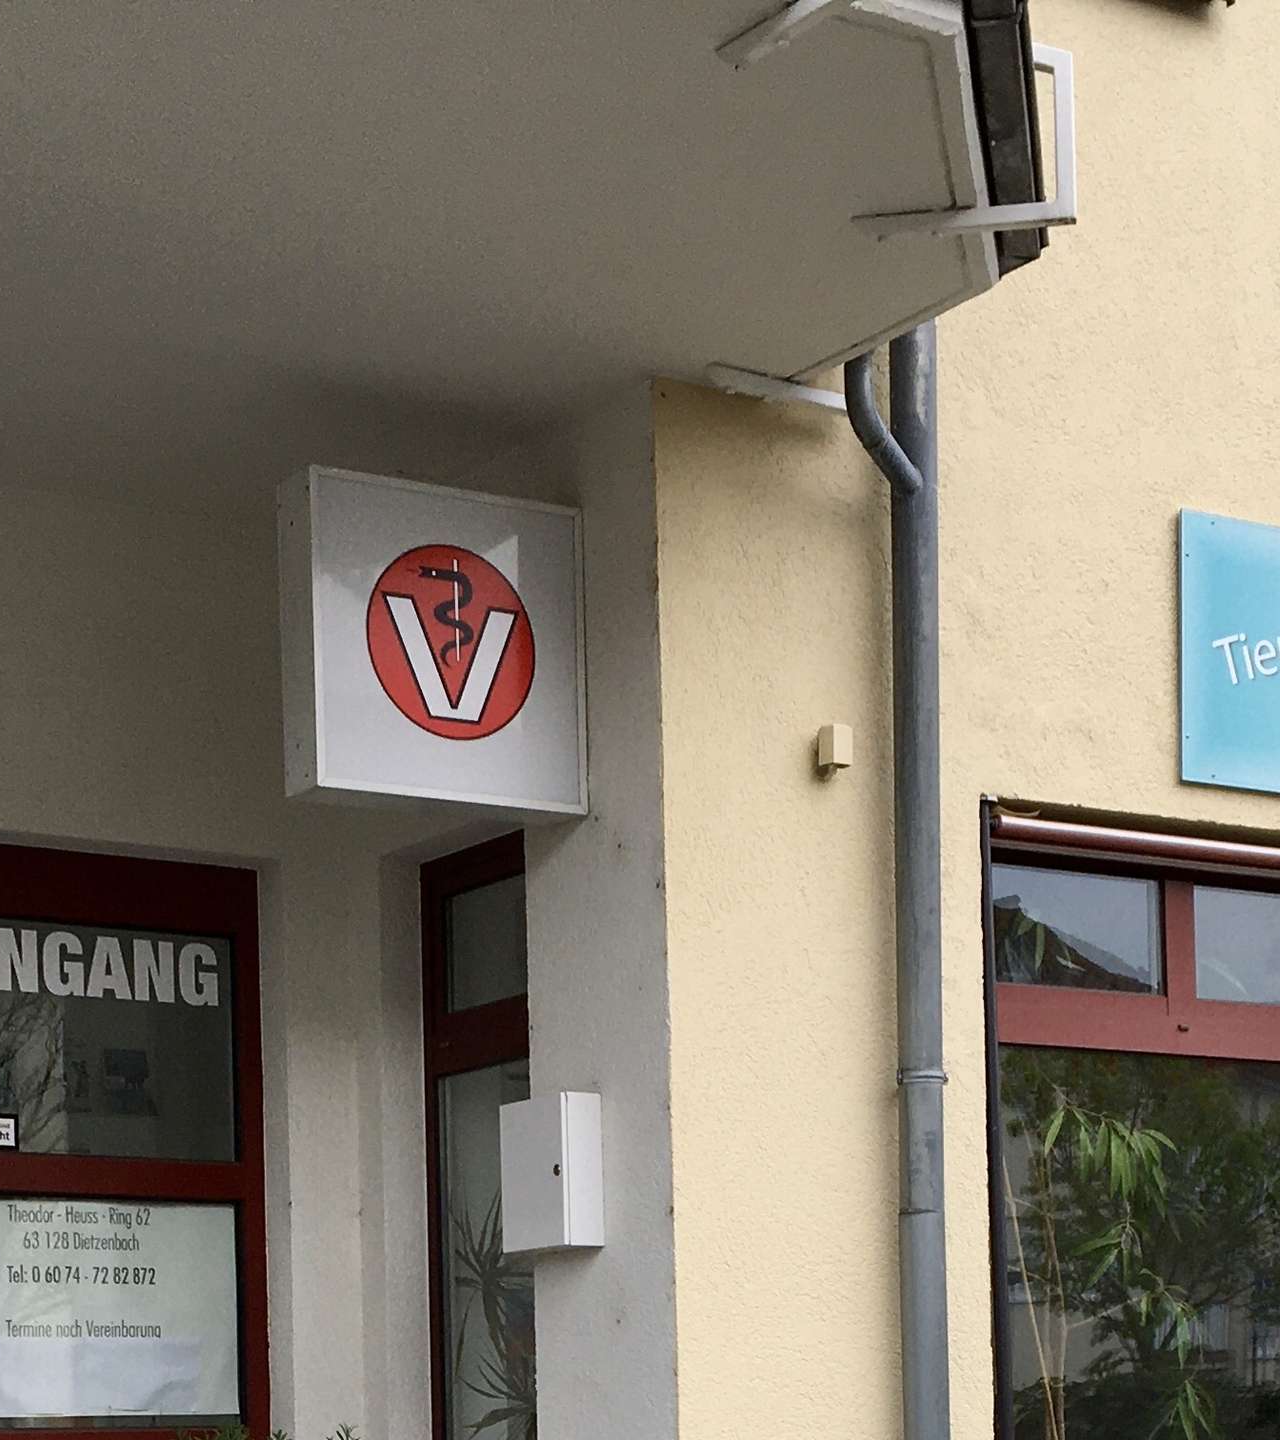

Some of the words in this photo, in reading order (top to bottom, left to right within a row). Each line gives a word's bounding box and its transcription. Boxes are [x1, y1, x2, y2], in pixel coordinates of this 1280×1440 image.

[7, 1204, 54, 1224] Theodor
[65, 1206, 99, 1224] Heuss
[108, 1207, 132, 1229] Ring
[135, 1208, 151, 1226] 62
[23, 1231, 40, 1249] 63
[45, 1231, 70, 1250] 128
[73, 1232, 140, 1251] Dietzenbach
[6, 1264, 28, 1283] Tel:
[31, 1266, 41, 1283] 0
[45, 1266, 61, 1283] 60
[65, 1266, 81, 1284] 74
[92, 1266, 109, 1284] 72
[113, 1267, 130, 1285] 82
[133, 1267, 156, 1285] 872
[5, 1319, 52, 1338] Termine
[56, 1319, 82, 1338] nach
